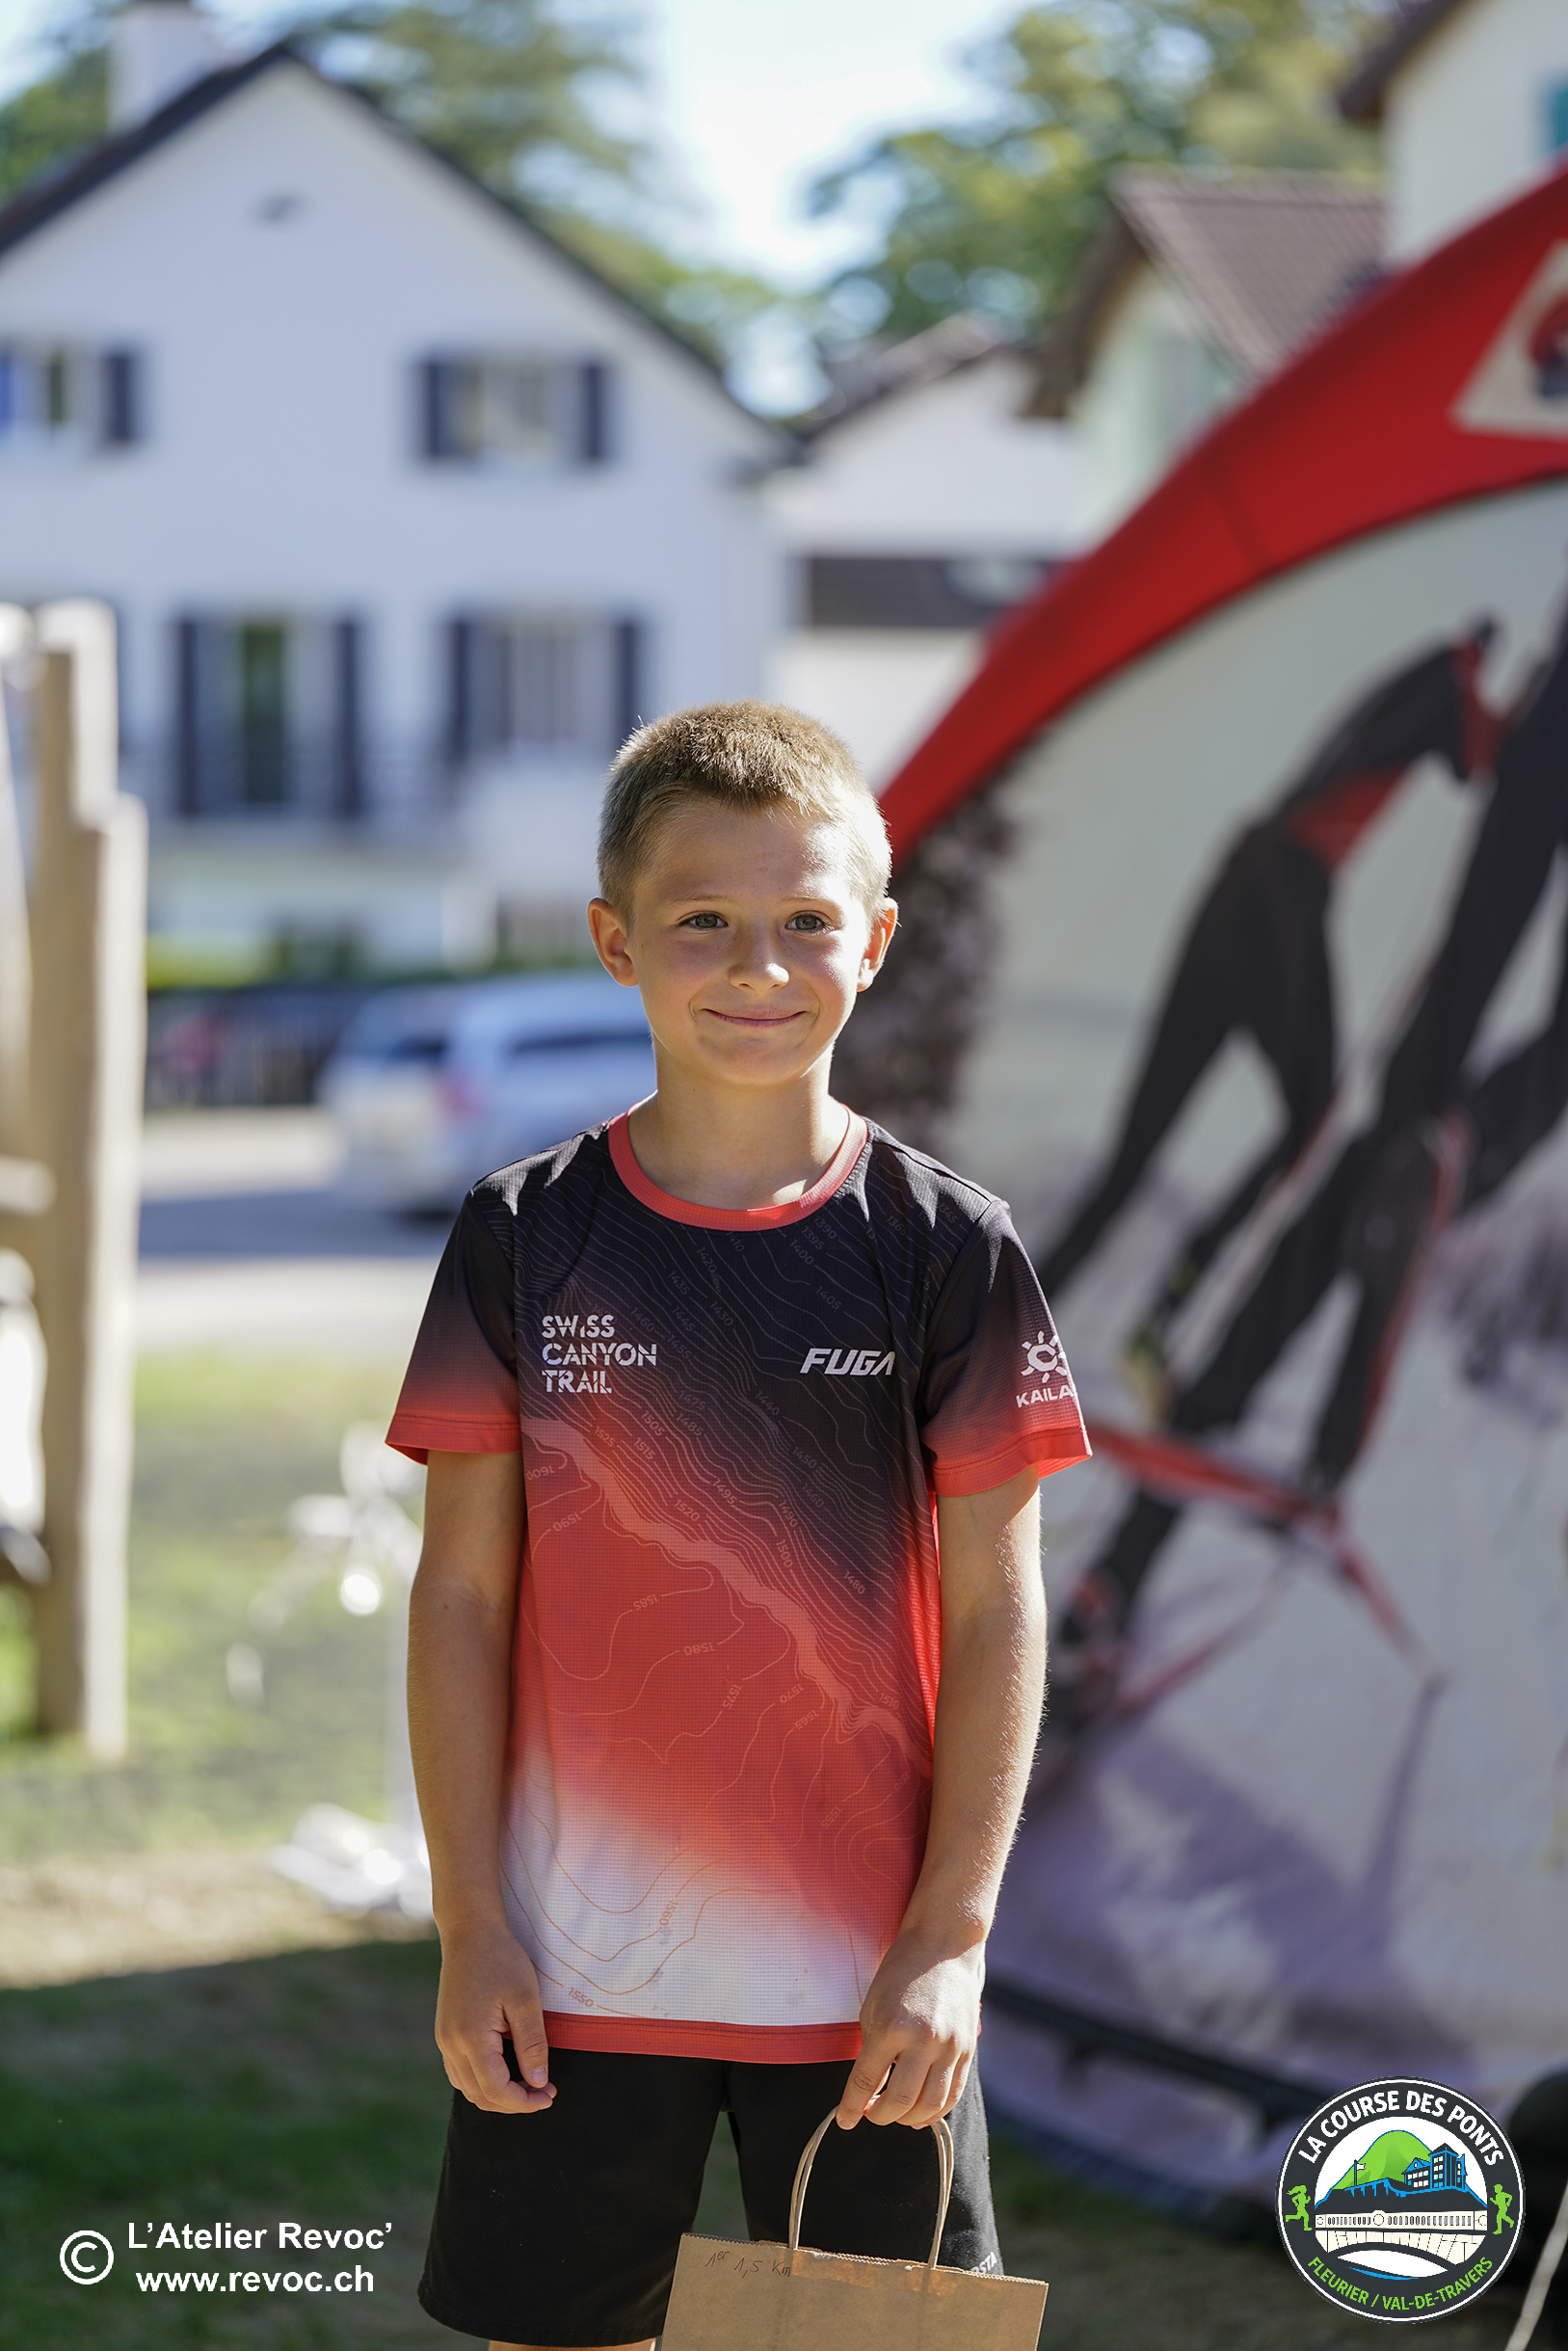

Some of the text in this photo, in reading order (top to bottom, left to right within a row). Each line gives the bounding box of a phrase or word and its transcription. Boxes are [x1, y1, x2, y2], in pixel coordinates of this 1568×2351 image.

[801, 1226, 826, 1250] 1395
[813, 1216, 837, 1240] 1390
[697, 1246, 718, 1272] 1420
[789, 1240, 814, 1266] 1400
[667, 1269, 691, 1296] 1435
[815, 1285, 842, 1310] 1405
[629, 1307, 655, 1333] 1460
[671, 1306, 697, 1332] 1445
[708, 1300, 734, 1326] 1430
[542, 1315, 616, 1339] SWISS
[542, 1343, 657, 1367] CANYON
[667, 1334, 692, 1360] 1455
[799, 1348, 896, 1376] FUGA
[542, 1370, 613, 1394] TRAIL
[679, 1389, 707, 1410] 1475
[755, 1390, 781, 1417] 1440
[640, 1410, 666, 1436] 1505
[676, 1412, 704, 1436] 1485
[594, 1426, 616, 1447] 1525
[633, 1437, 656, 1460] 1515
[791, 1446, 818, 1470] 1450
[712, 1478, 738, 1504] 1495
[552, 1512, 583, 1532] 1590
[674, 1499, 701, 1522] 1520
[778, 1499, 799, 1528] 1490
[776, 1539, 794, 1568] 1500
[843, 1570, 866, 1594] 1480
[658, 1900, 679, 1926] 1560
[567, 1987, 595, 2008] 1550
[704, 2250, 731, 2267] 1er
[733, 2257, 763, 2279] 1,5
